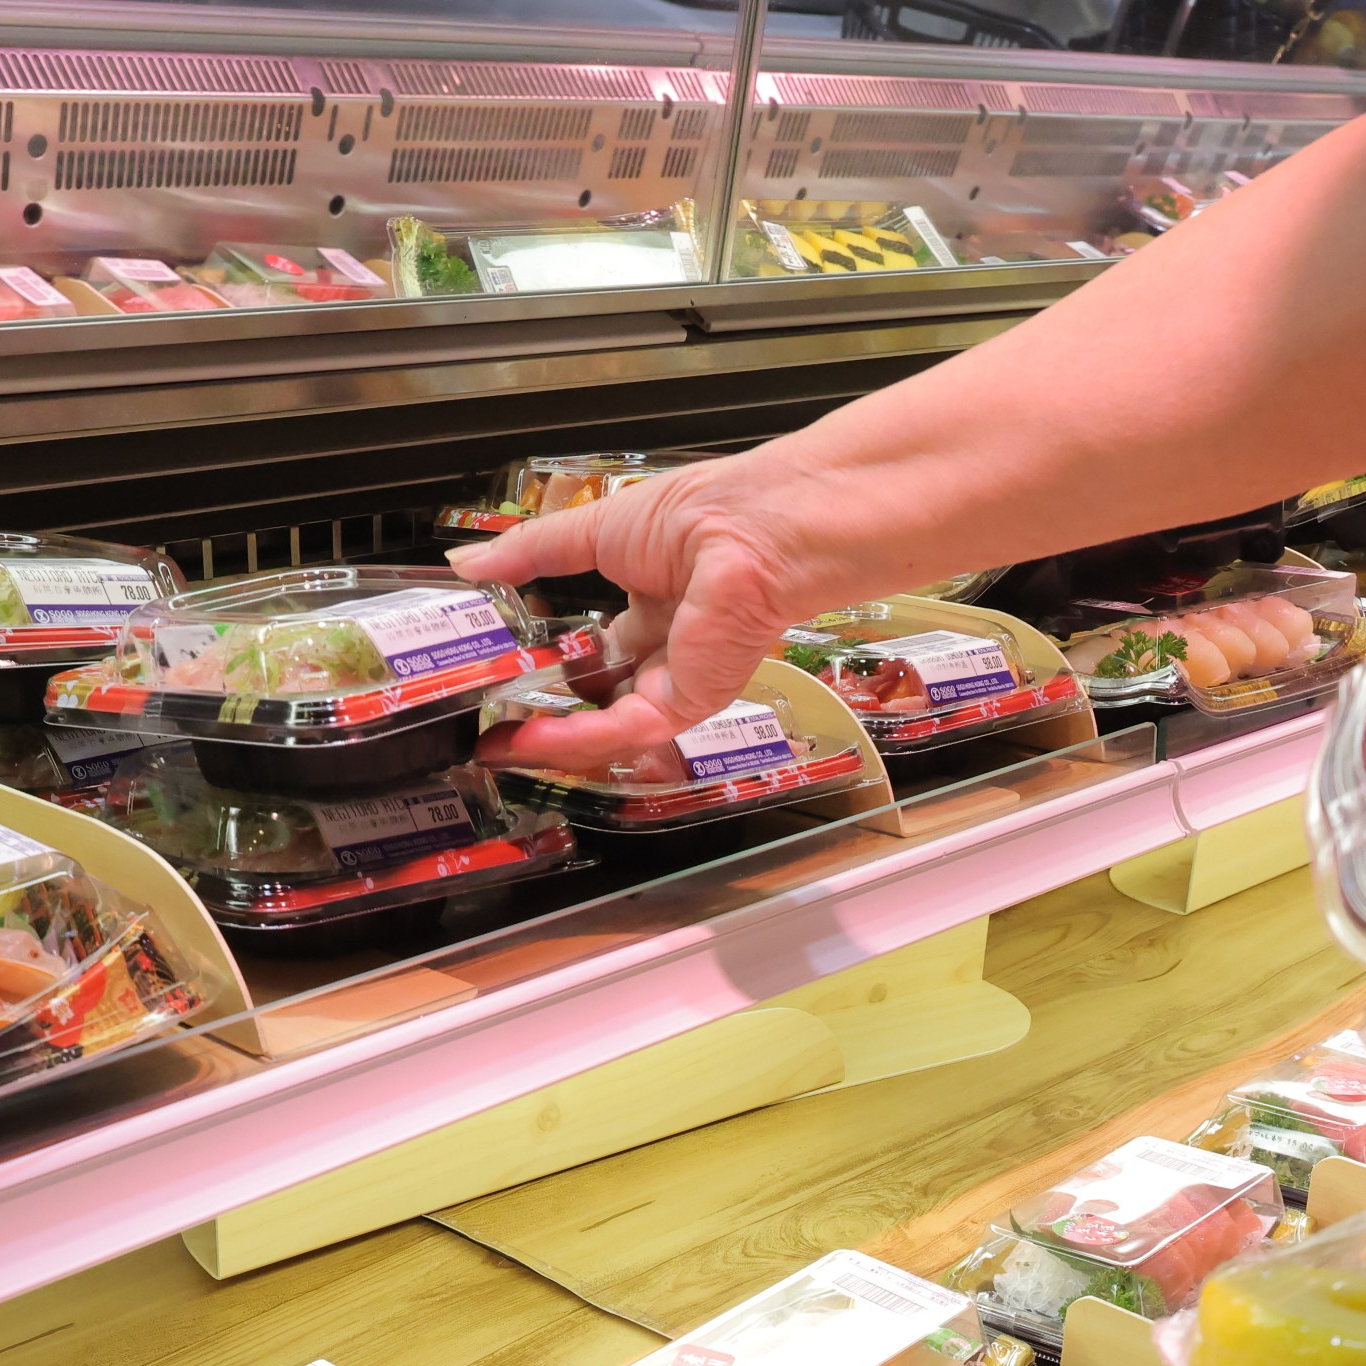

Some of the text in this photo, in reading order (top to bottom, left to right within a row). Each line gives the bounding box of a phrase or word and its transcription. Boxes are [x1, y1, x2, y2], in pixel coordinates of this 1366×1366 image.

[120, 585, 152, 600] 78.00
[465, 609, 496, 629] 78.00
[981, 655, 1003, 670] 98.00
[753, 723, 779, 740] 98.00
[85, 760, 110, 771] SOGO
[703, 758, 723, 770] SOGO
[427, 803, 460, 823] 78.00
[354, 847, 381, 858] SOGO
